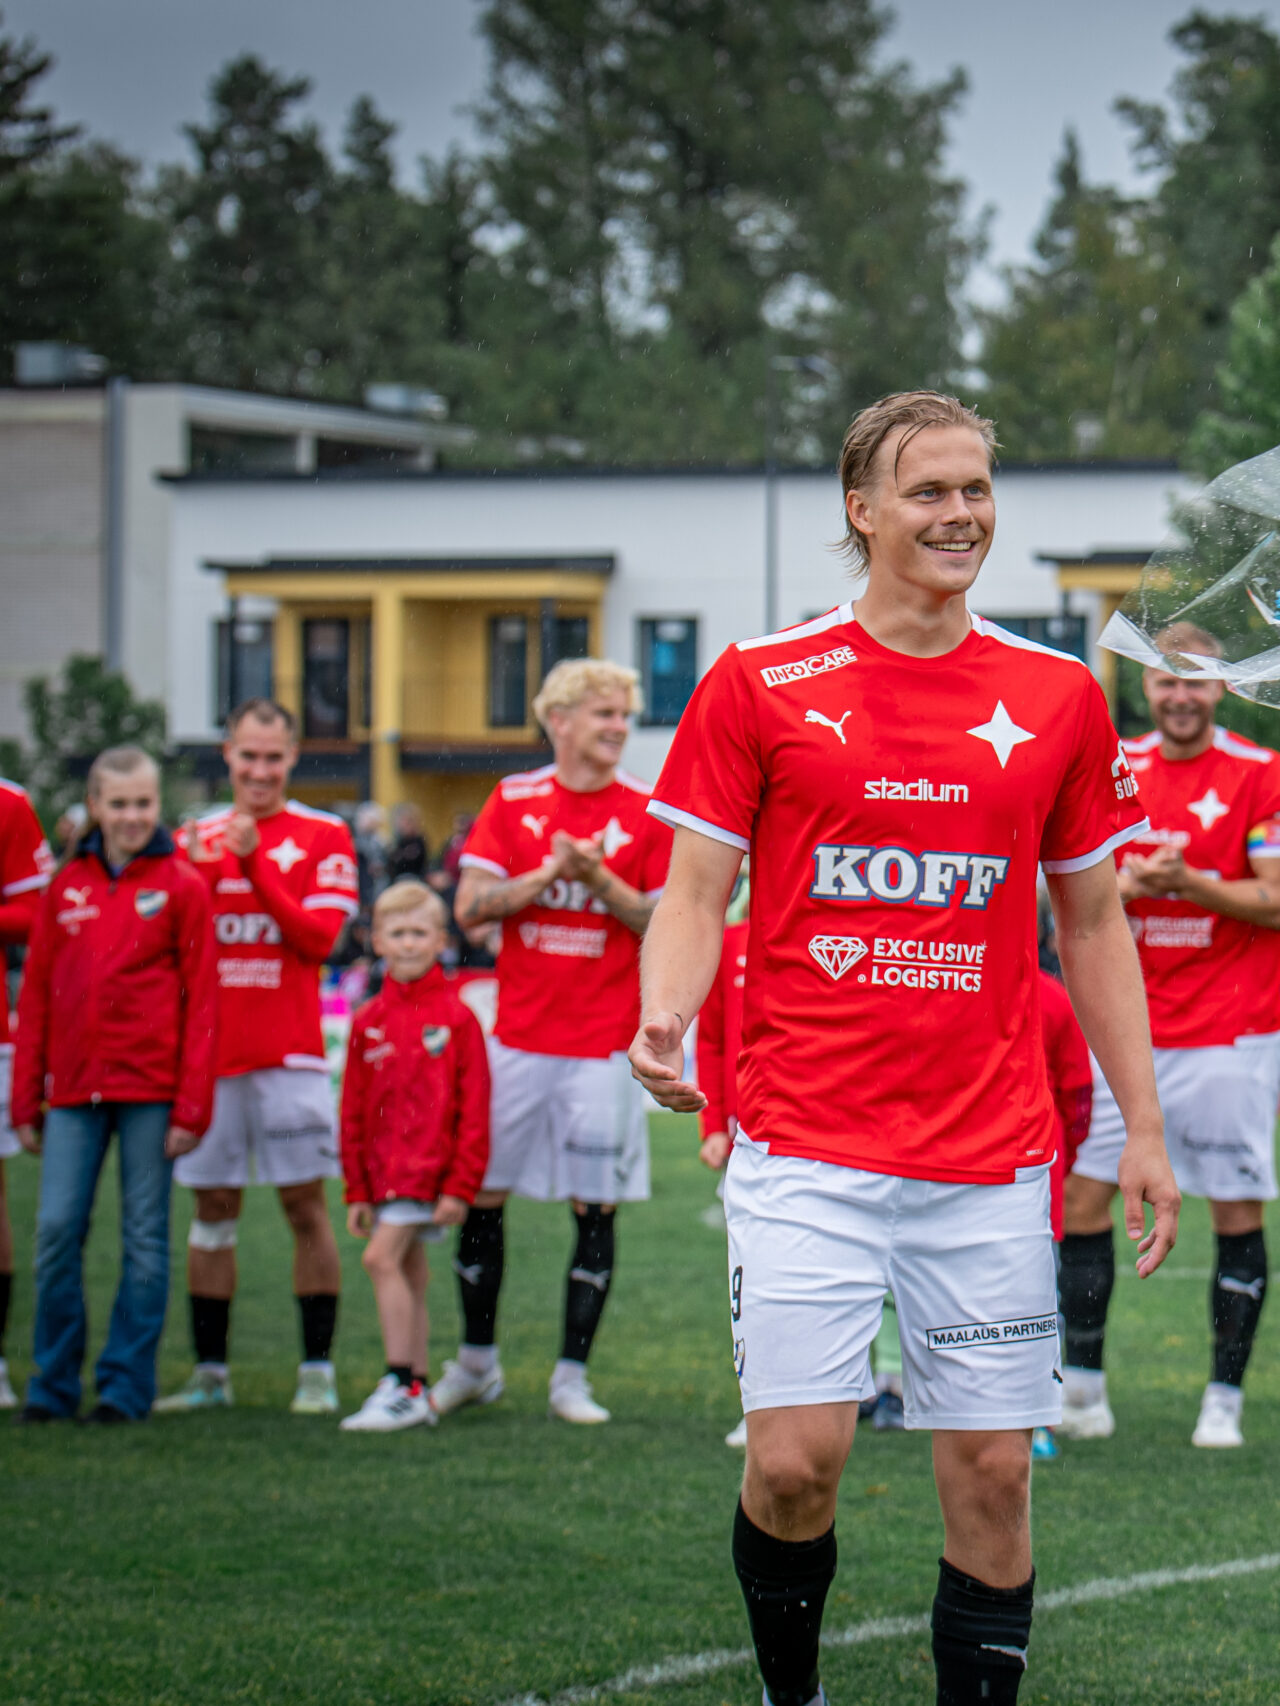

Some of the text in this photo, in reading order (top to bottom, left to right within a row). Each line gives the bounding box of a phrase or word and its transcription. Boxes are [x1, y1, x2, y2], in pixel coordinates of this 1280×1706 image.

[864, 777, 968, 802] stadium
[809, 844, 1009, 909] KOFF
[873, 937, 983, 964] EXCLUSIVE
[871, 965, 982, 992] LOGISTICS
[731, 1265, 743, 1322] 9
[933, 1318, 1057, 1345] MAALAUS PARTNERS
